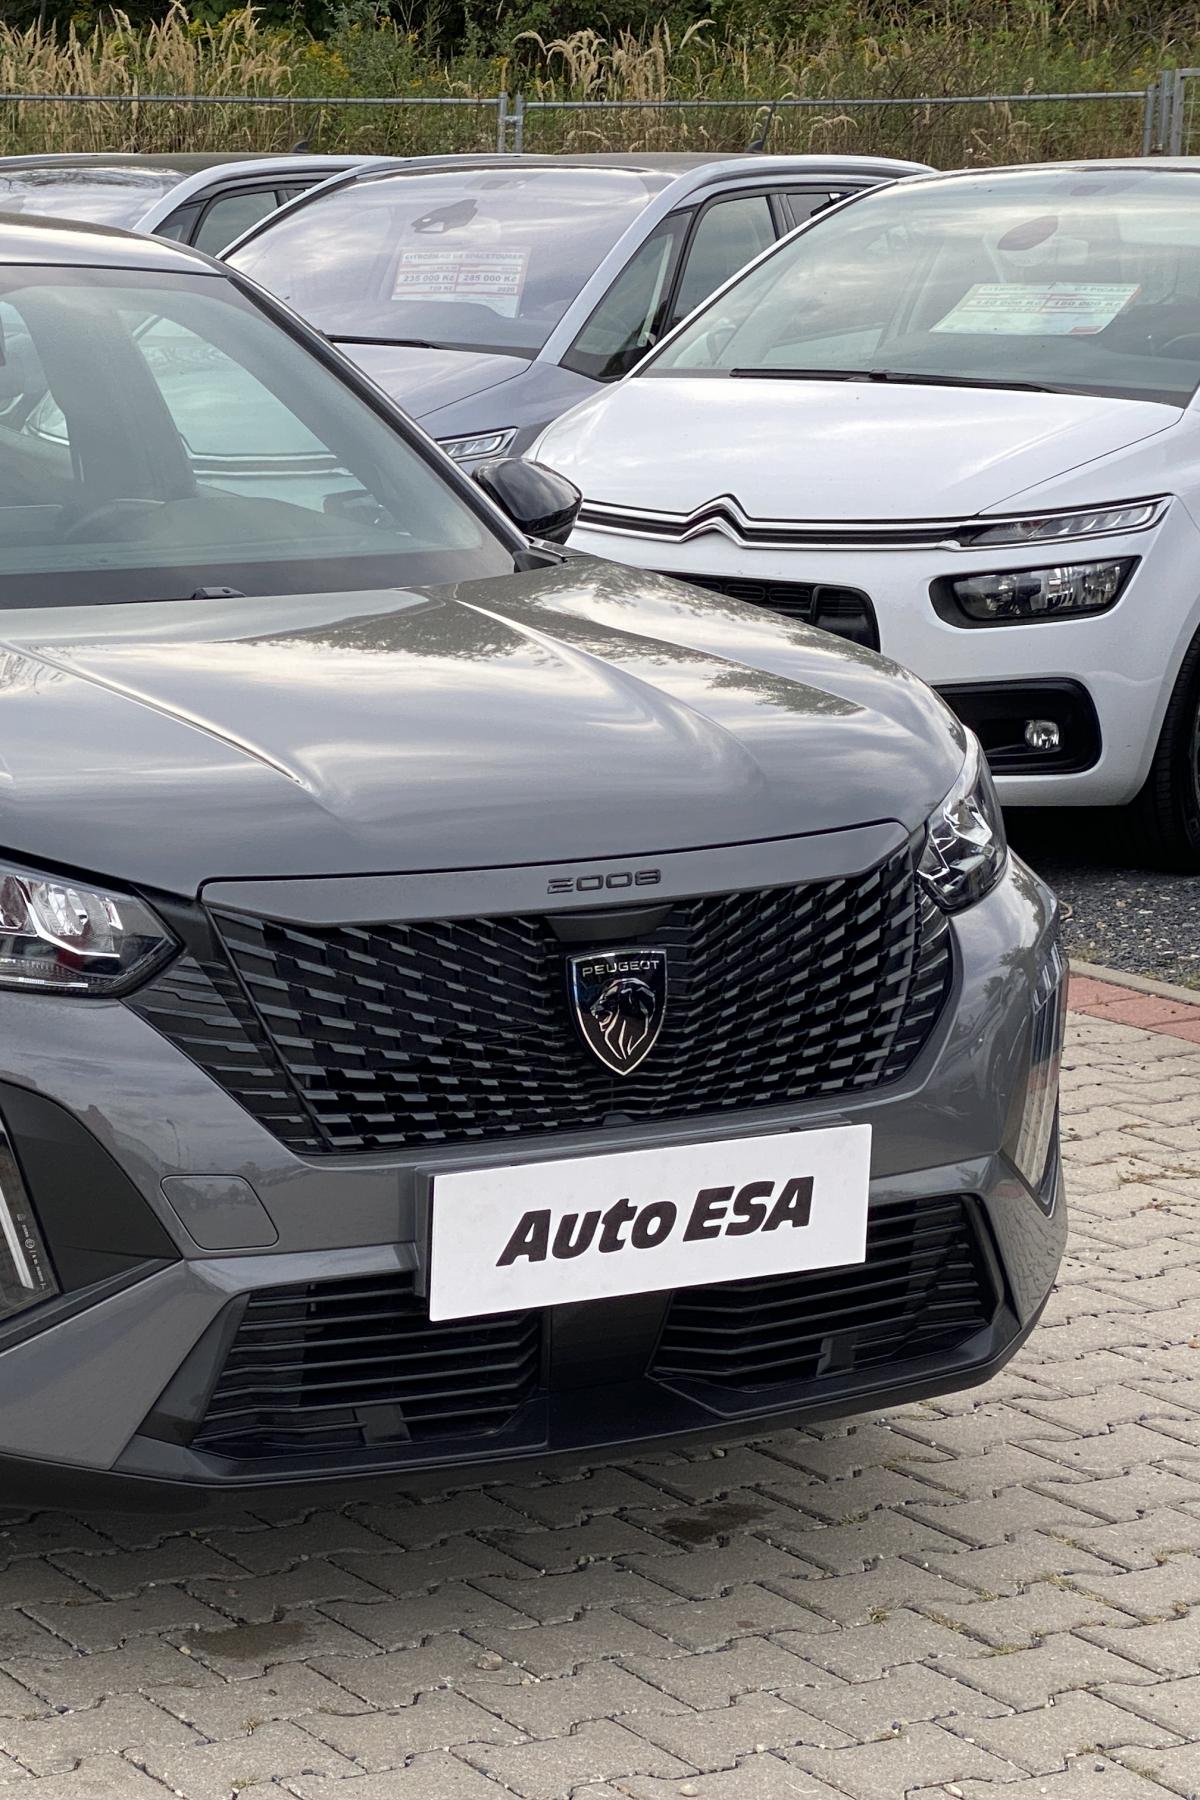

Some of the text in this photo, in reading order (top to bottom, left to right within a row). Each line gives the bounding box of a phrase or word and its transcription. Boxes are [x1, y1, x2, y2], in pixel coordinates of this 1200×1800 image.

[547, 868, 662, 894] 2008
[582, 959, 660, 978] PEUGEOT
[495, 1175, 815, 1267] Auto ESA
